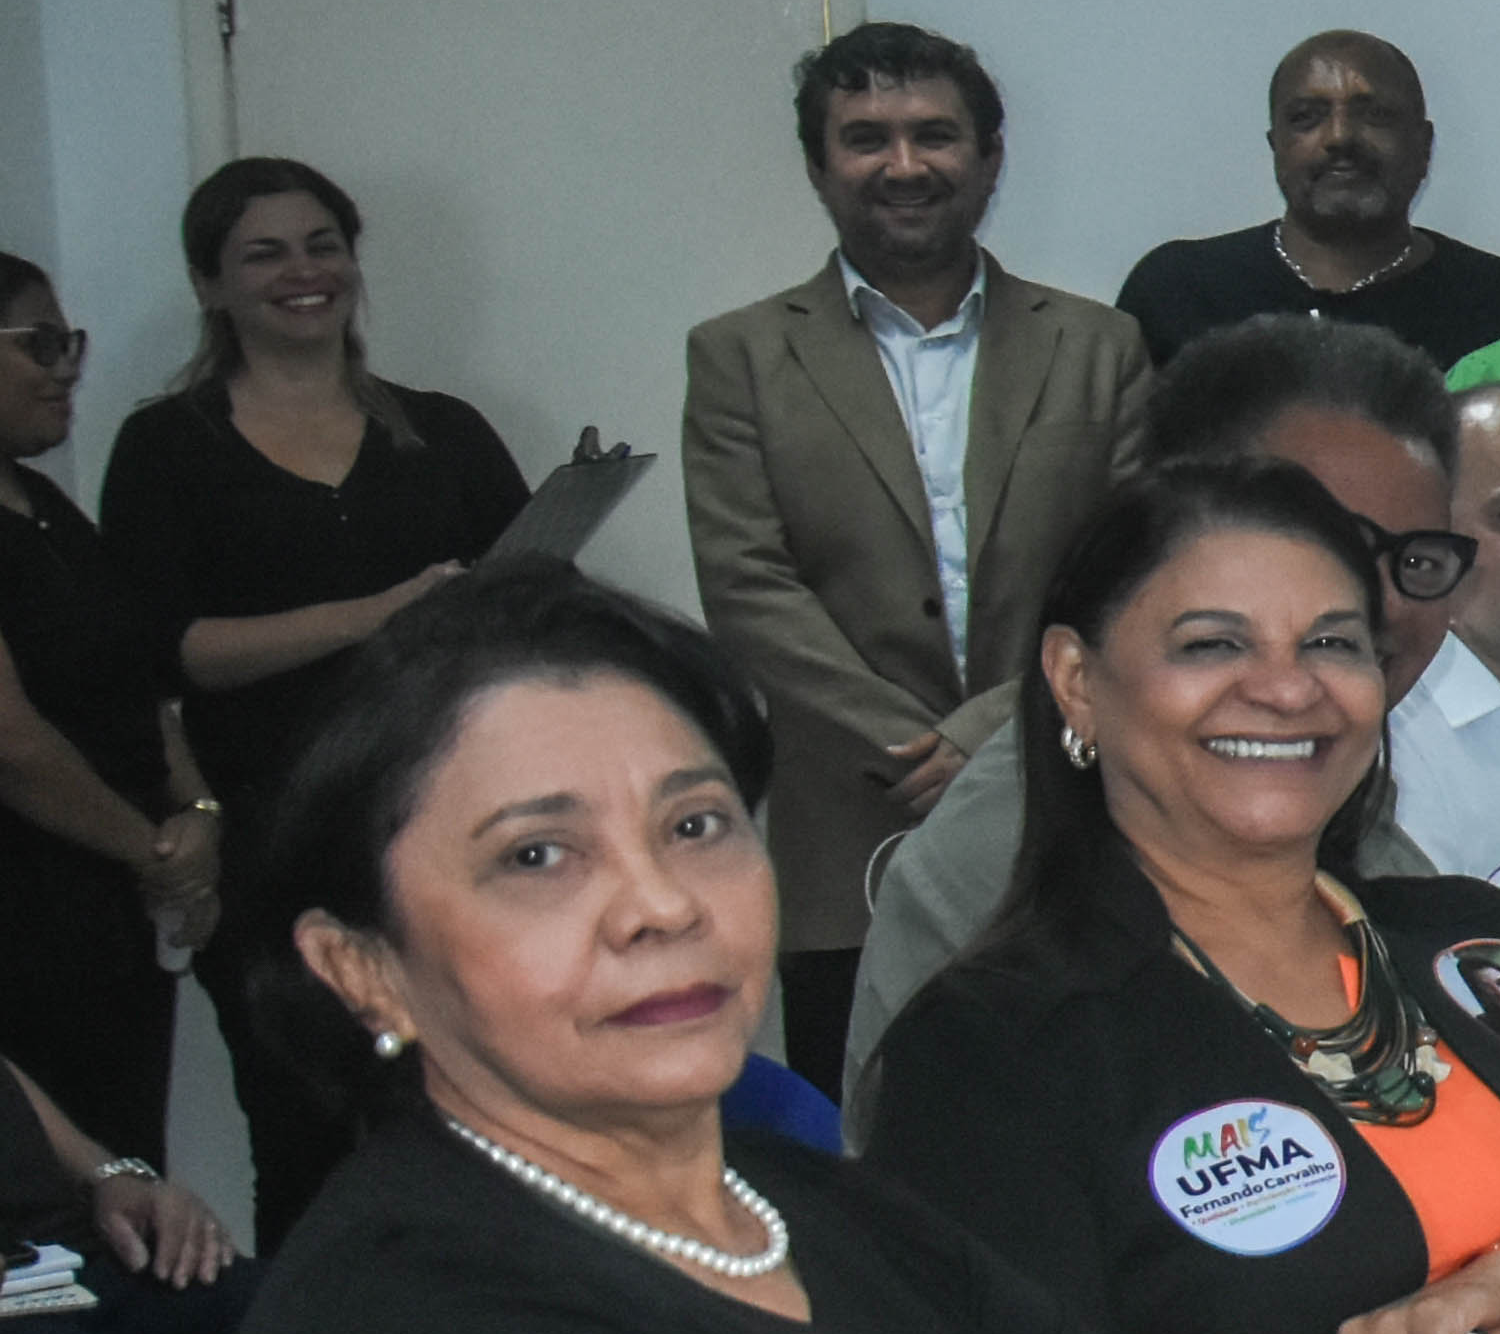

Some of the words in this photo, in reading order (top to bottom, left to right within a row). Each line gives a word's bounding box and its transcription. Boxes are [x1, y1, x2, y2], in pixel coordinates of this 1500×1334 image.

[1176, 1137, 1314, 1197] UFMA
[1184, 1107, 1271, 1169] MAIS
[1180, 1182, 1264, 1219] Fernando
[1264, 1161, 1336, 1190] Carvalho
